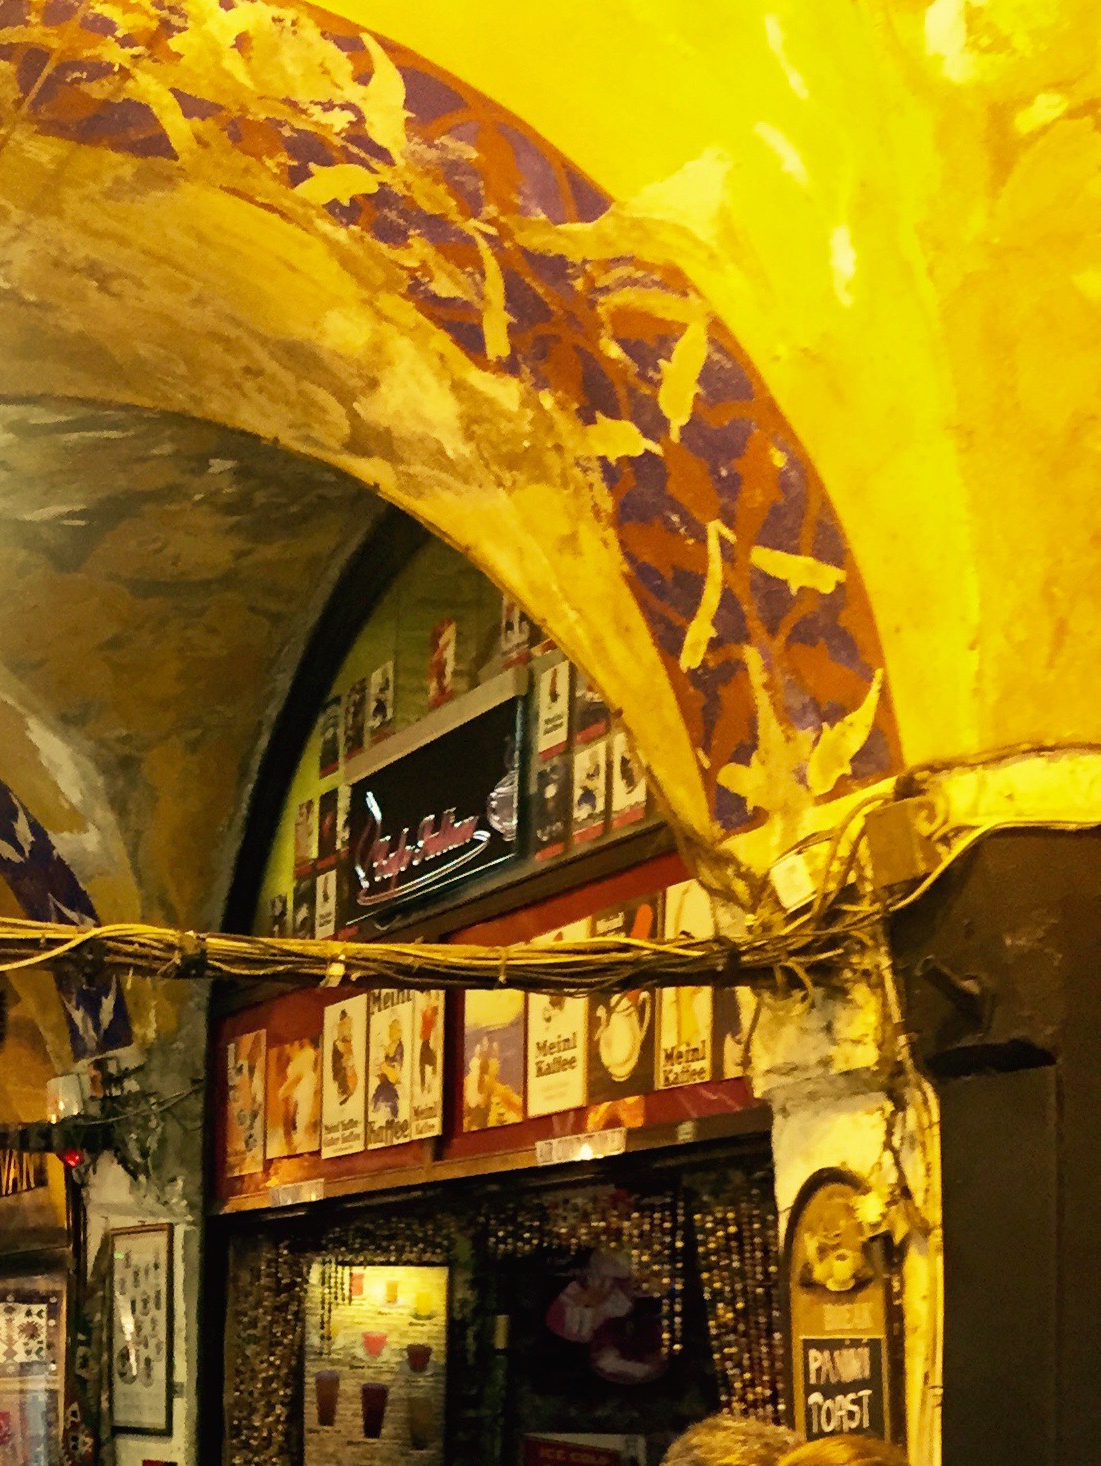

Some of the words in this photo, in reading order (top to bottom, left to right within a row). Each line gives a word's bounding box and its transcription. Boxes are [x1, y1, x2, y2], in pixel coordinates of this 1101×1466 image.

[535, 1032, 577, 1058] Meinl
[663, 1039, 707, 1062] Meinl
[535, 1055, 577, 1078] Kaffee
[662, 1066, 706, 1087] Kaffee
[808, 1389, 873, 1434] TOAST
